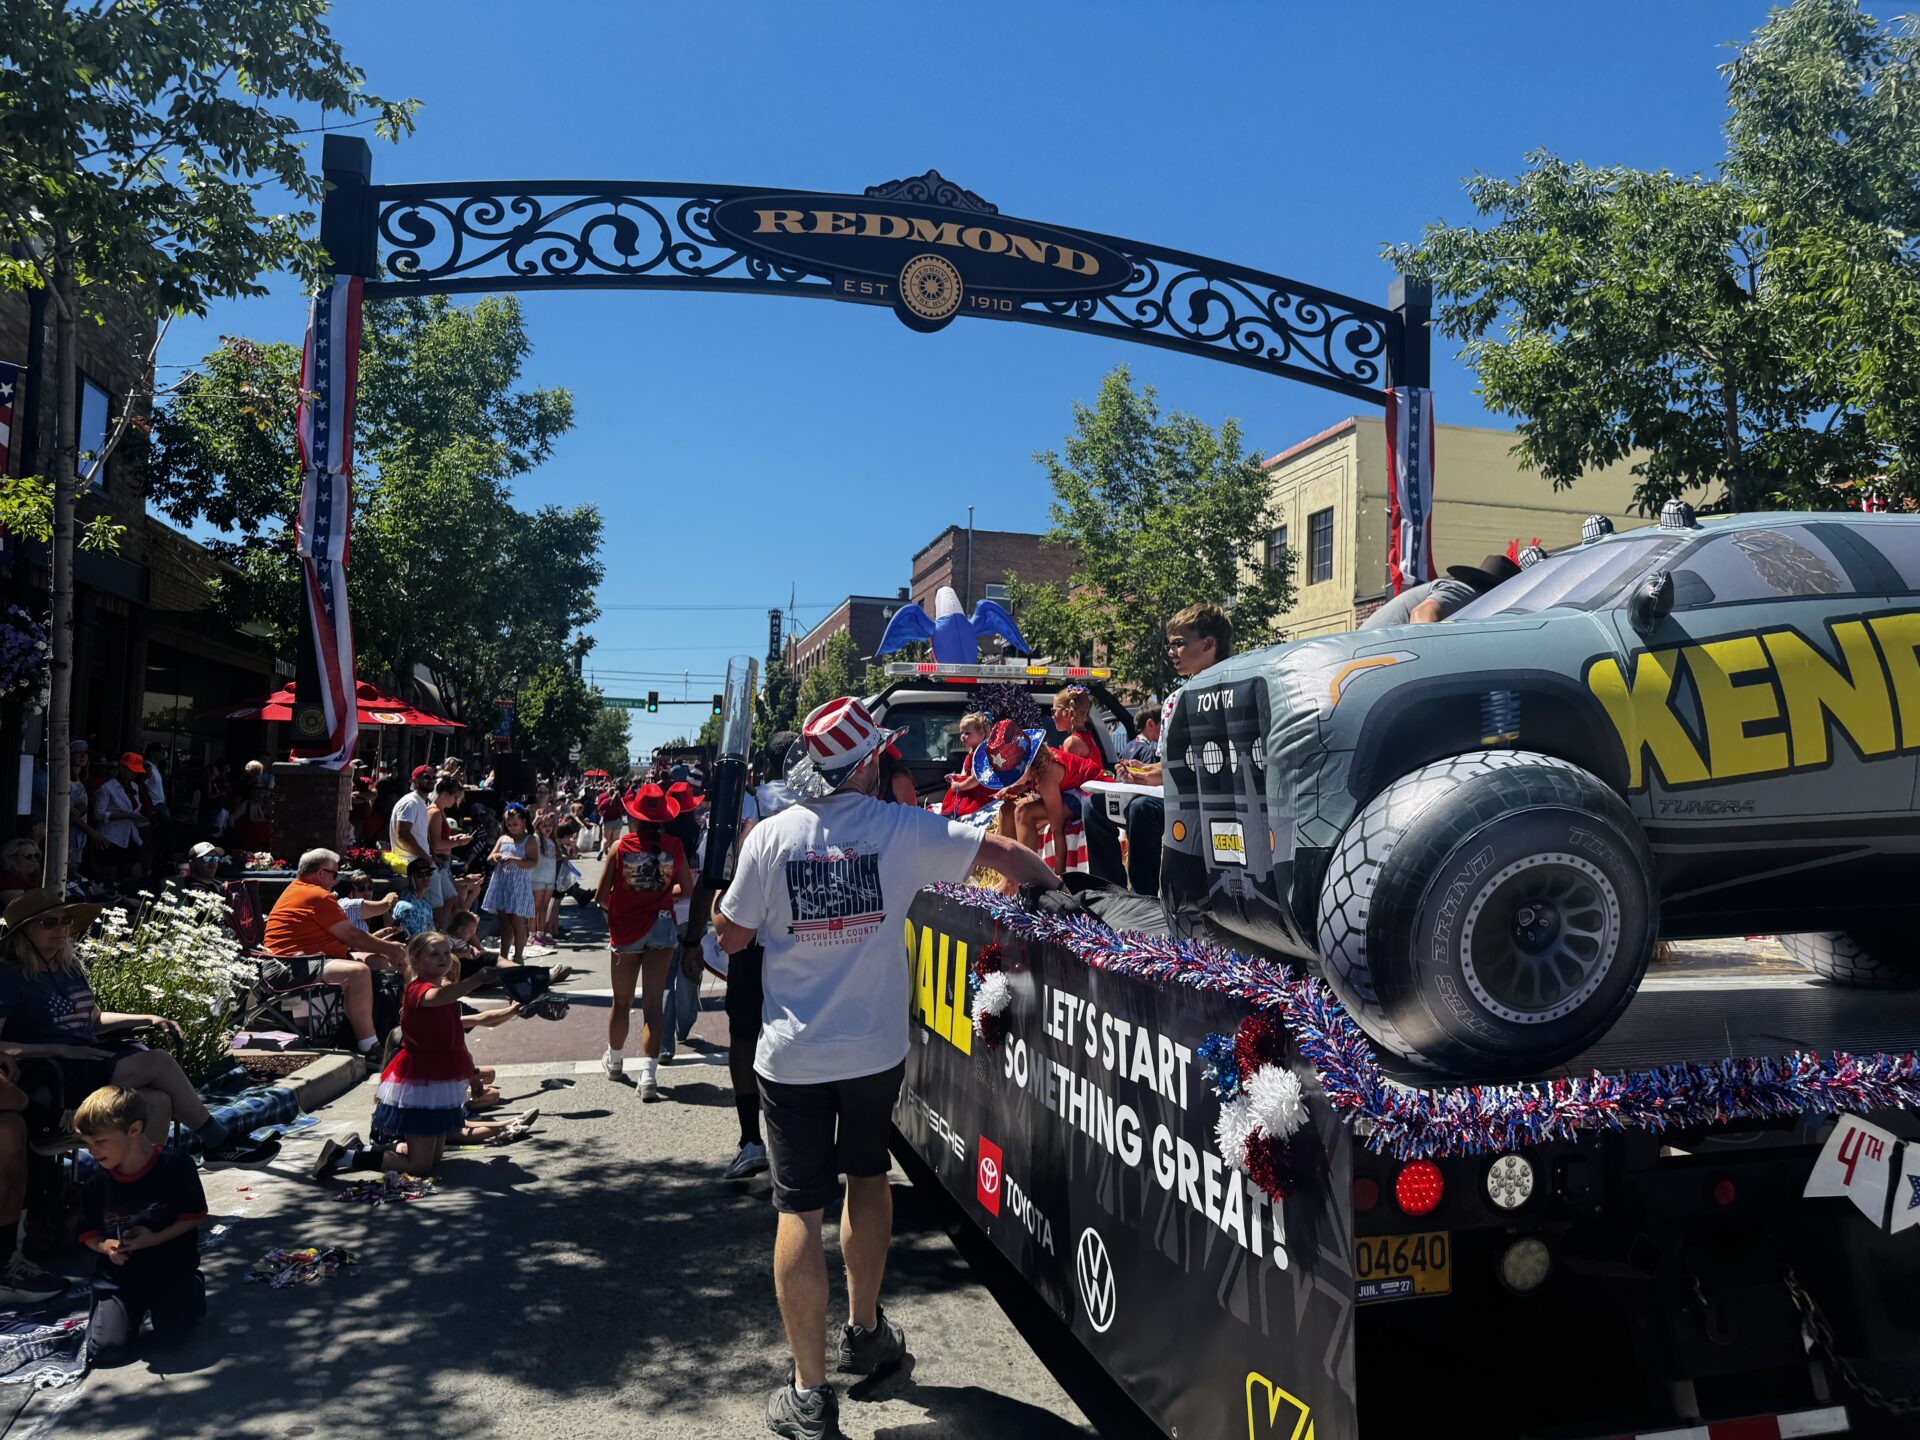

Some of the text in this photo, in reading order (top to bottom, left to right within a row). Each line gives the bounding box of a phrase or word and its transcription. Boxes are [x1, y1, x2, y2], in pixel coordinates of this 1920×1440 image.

[753, 209, 1100, 277] REDMOND
[914, 267, 949, 284] REDMOND
[843, 279, 1013, 312] EST 1910
[771, 618, 780, 658] HOTEL
[1197, 689, 1234, 713] TOYTA
[1658, 799, 1755, 815] TUNDRA
[805, 847, 859, 862] Driven By
[1431, 845, 1496, 964] BRAND
[795, 925, 879, 943] DESCHUTES COUNTY
[841, 937, 863, 945] RODEO
[1042, 984, 1192, 1111] LET'S START
[906, 1086, 966, 1162] PORSCHE
[1004, 1031, 1289, 1271] SOMETHING GREAT!
[1004, 1173, 1055, 1257] TOYOTA
[1355, 1235, 1446, 1278] 04640
[1358, 1284, 1379, 1297] JUN.
[1400, 1280, 1411, 1292] 27
